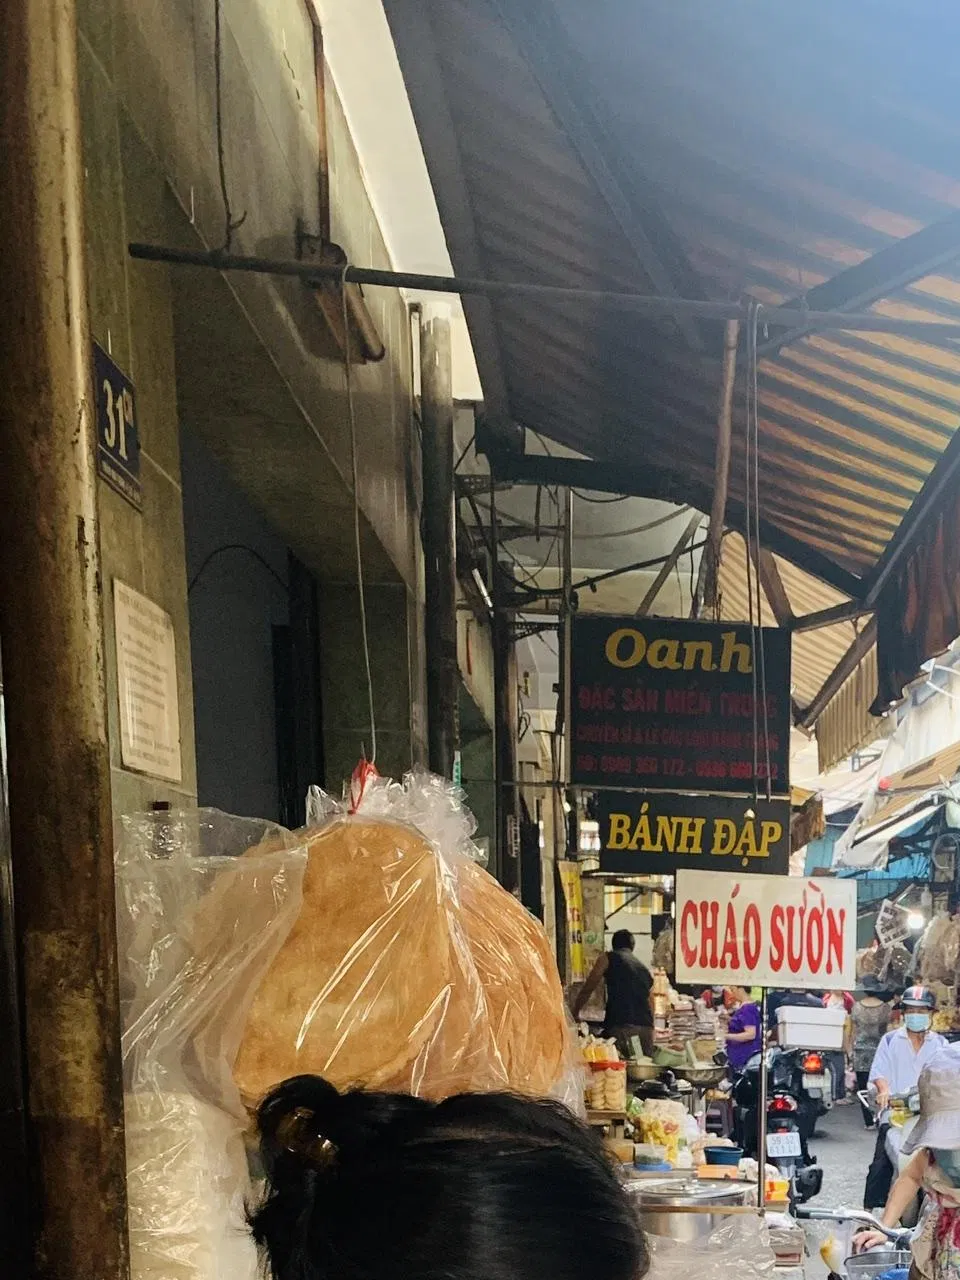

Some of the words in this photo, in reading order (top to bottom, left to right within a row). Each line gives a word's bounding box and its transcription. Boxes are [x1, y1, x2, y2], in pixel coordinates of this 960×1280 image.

[605, 628, 753, 674] Oanh
[606, 802, 705, 854] BÁNH
[712, 809, 783, 867] ĐẬP
[681, 883, 762, 971] CHÁO
[769, 881, 846, 975] SƯỜN
